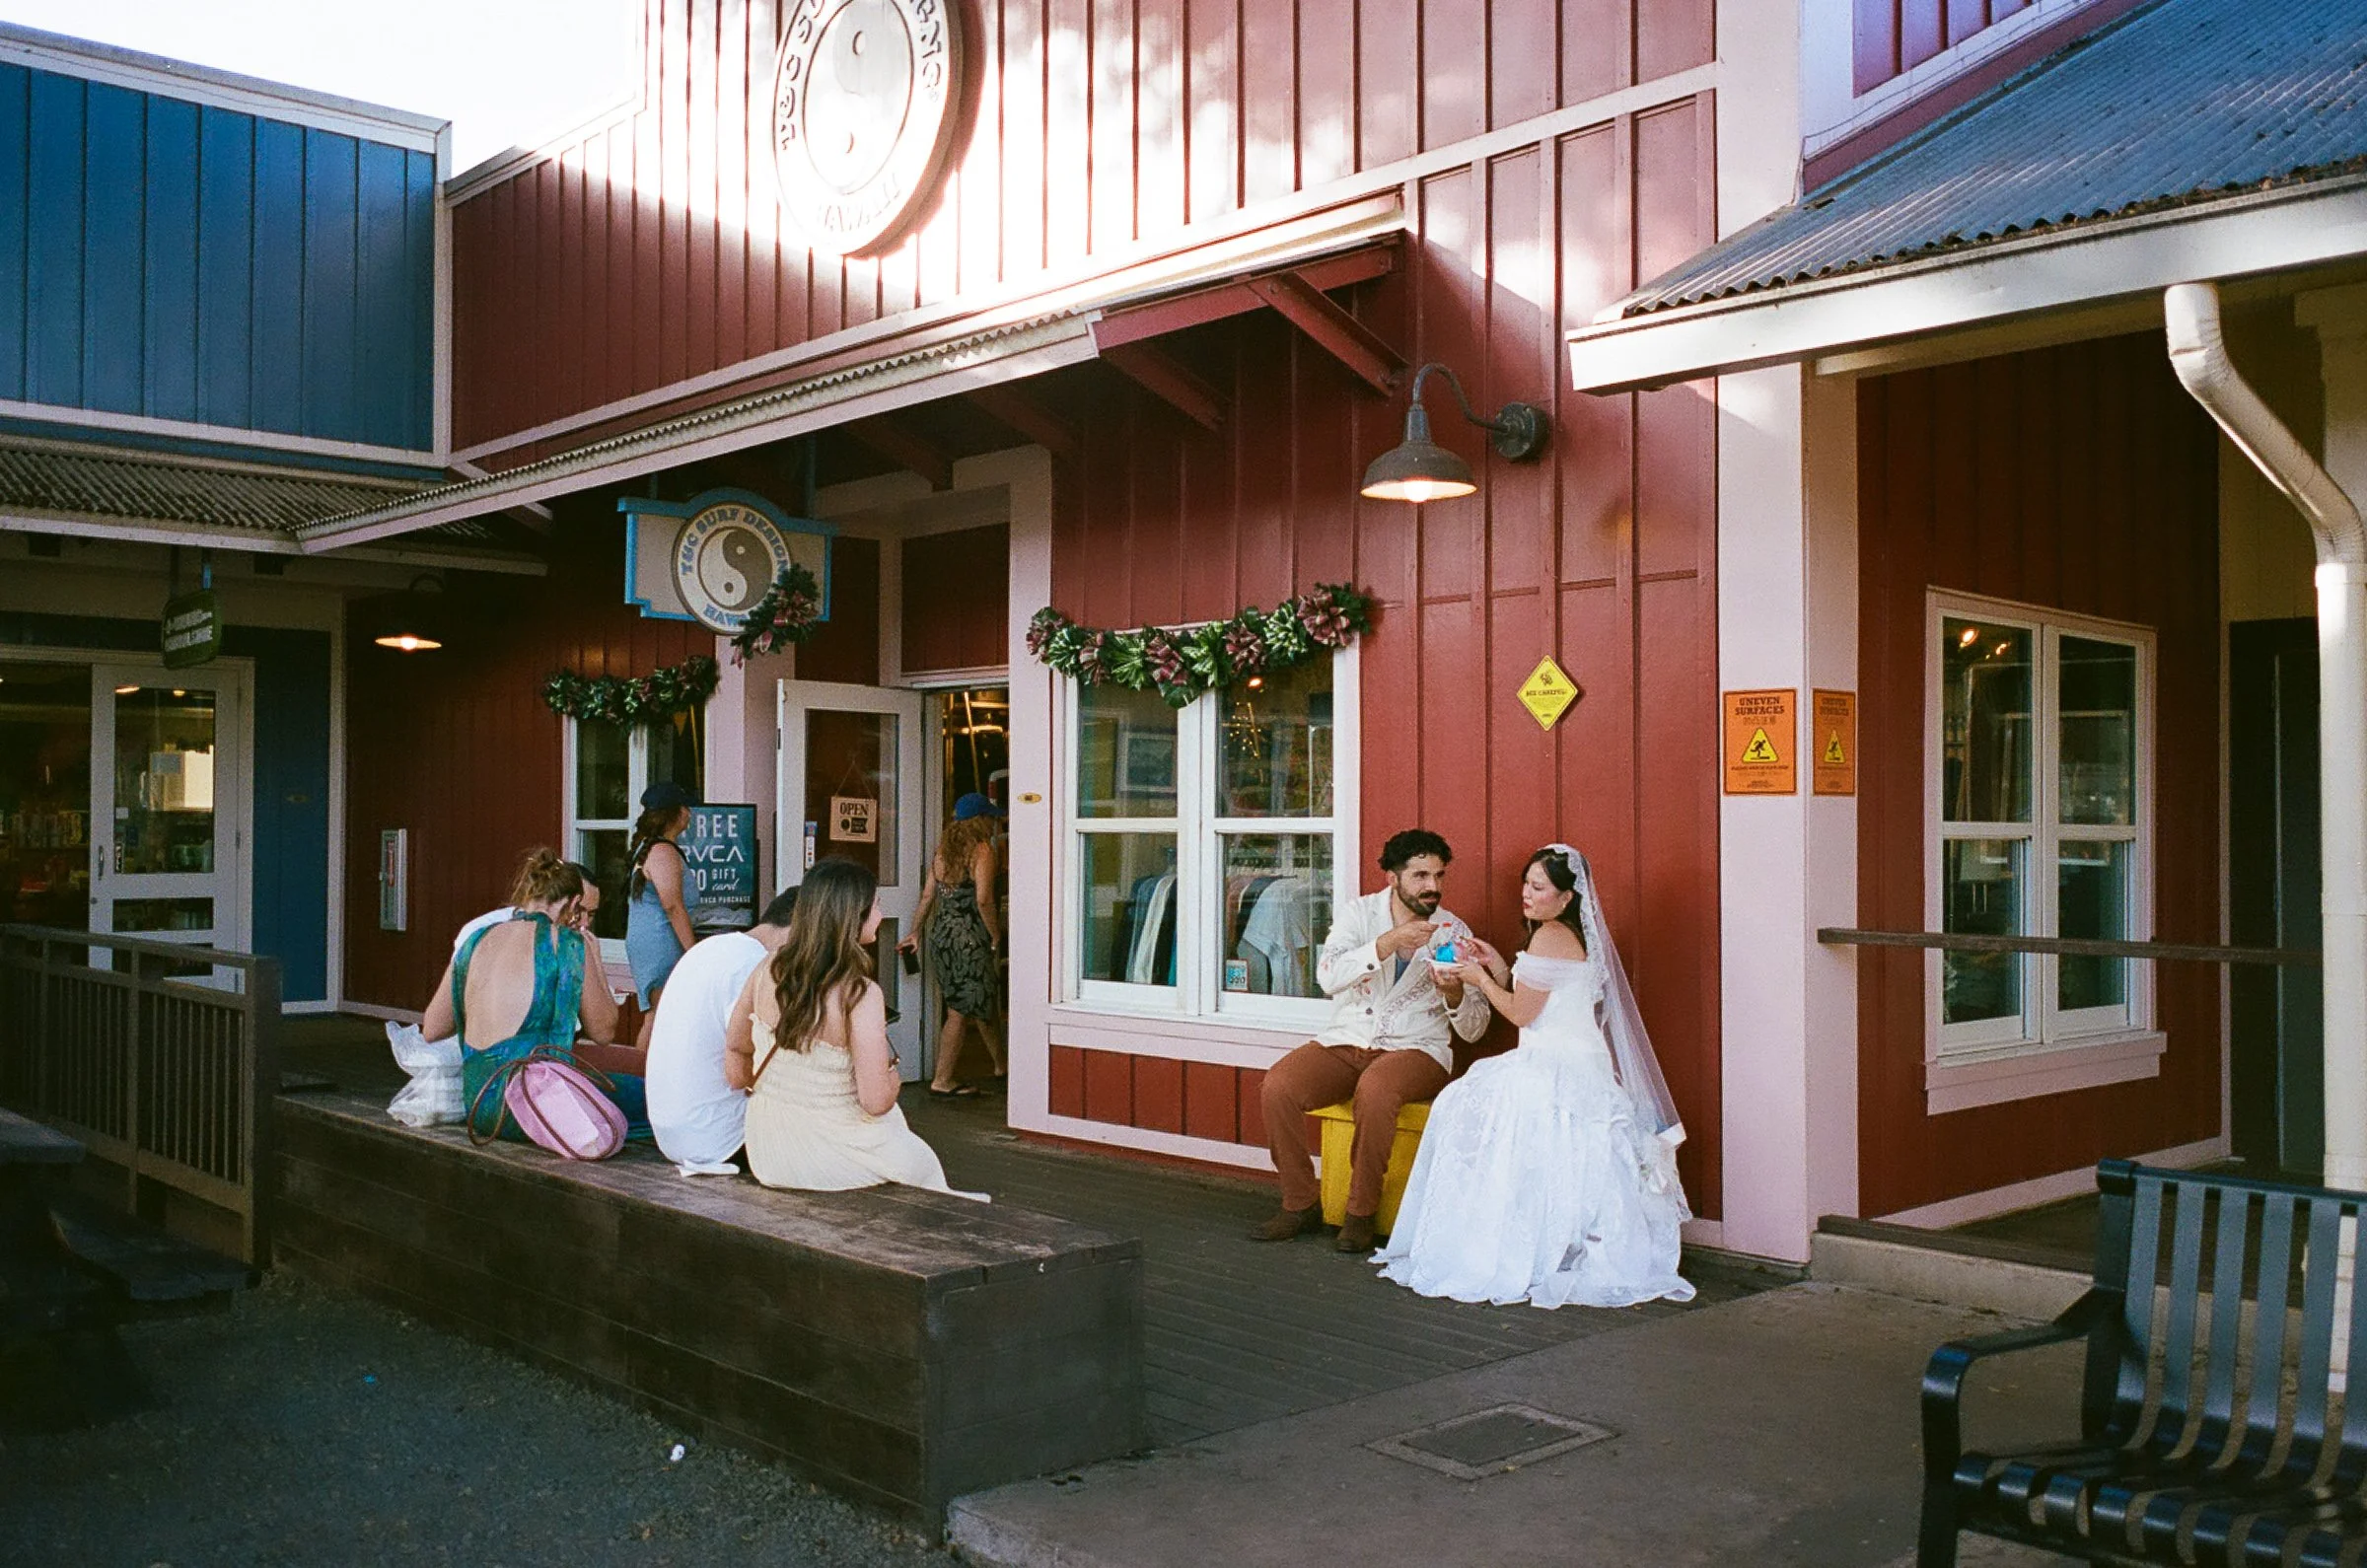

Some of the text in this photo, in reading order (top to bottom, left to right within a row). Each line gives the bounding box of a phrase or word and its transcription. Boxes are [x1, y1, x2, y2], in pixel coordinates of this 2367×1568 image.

[695, 508, 739, 535] SURF
[1739, 696, 1780, 706] UNEVEN
[1735, 705, 1785, 716] SURFACES
[839, 801, 869, 817] OPEN
[682, 815, 739, 838] REE
[712, 868, 737, 881] GIFT
